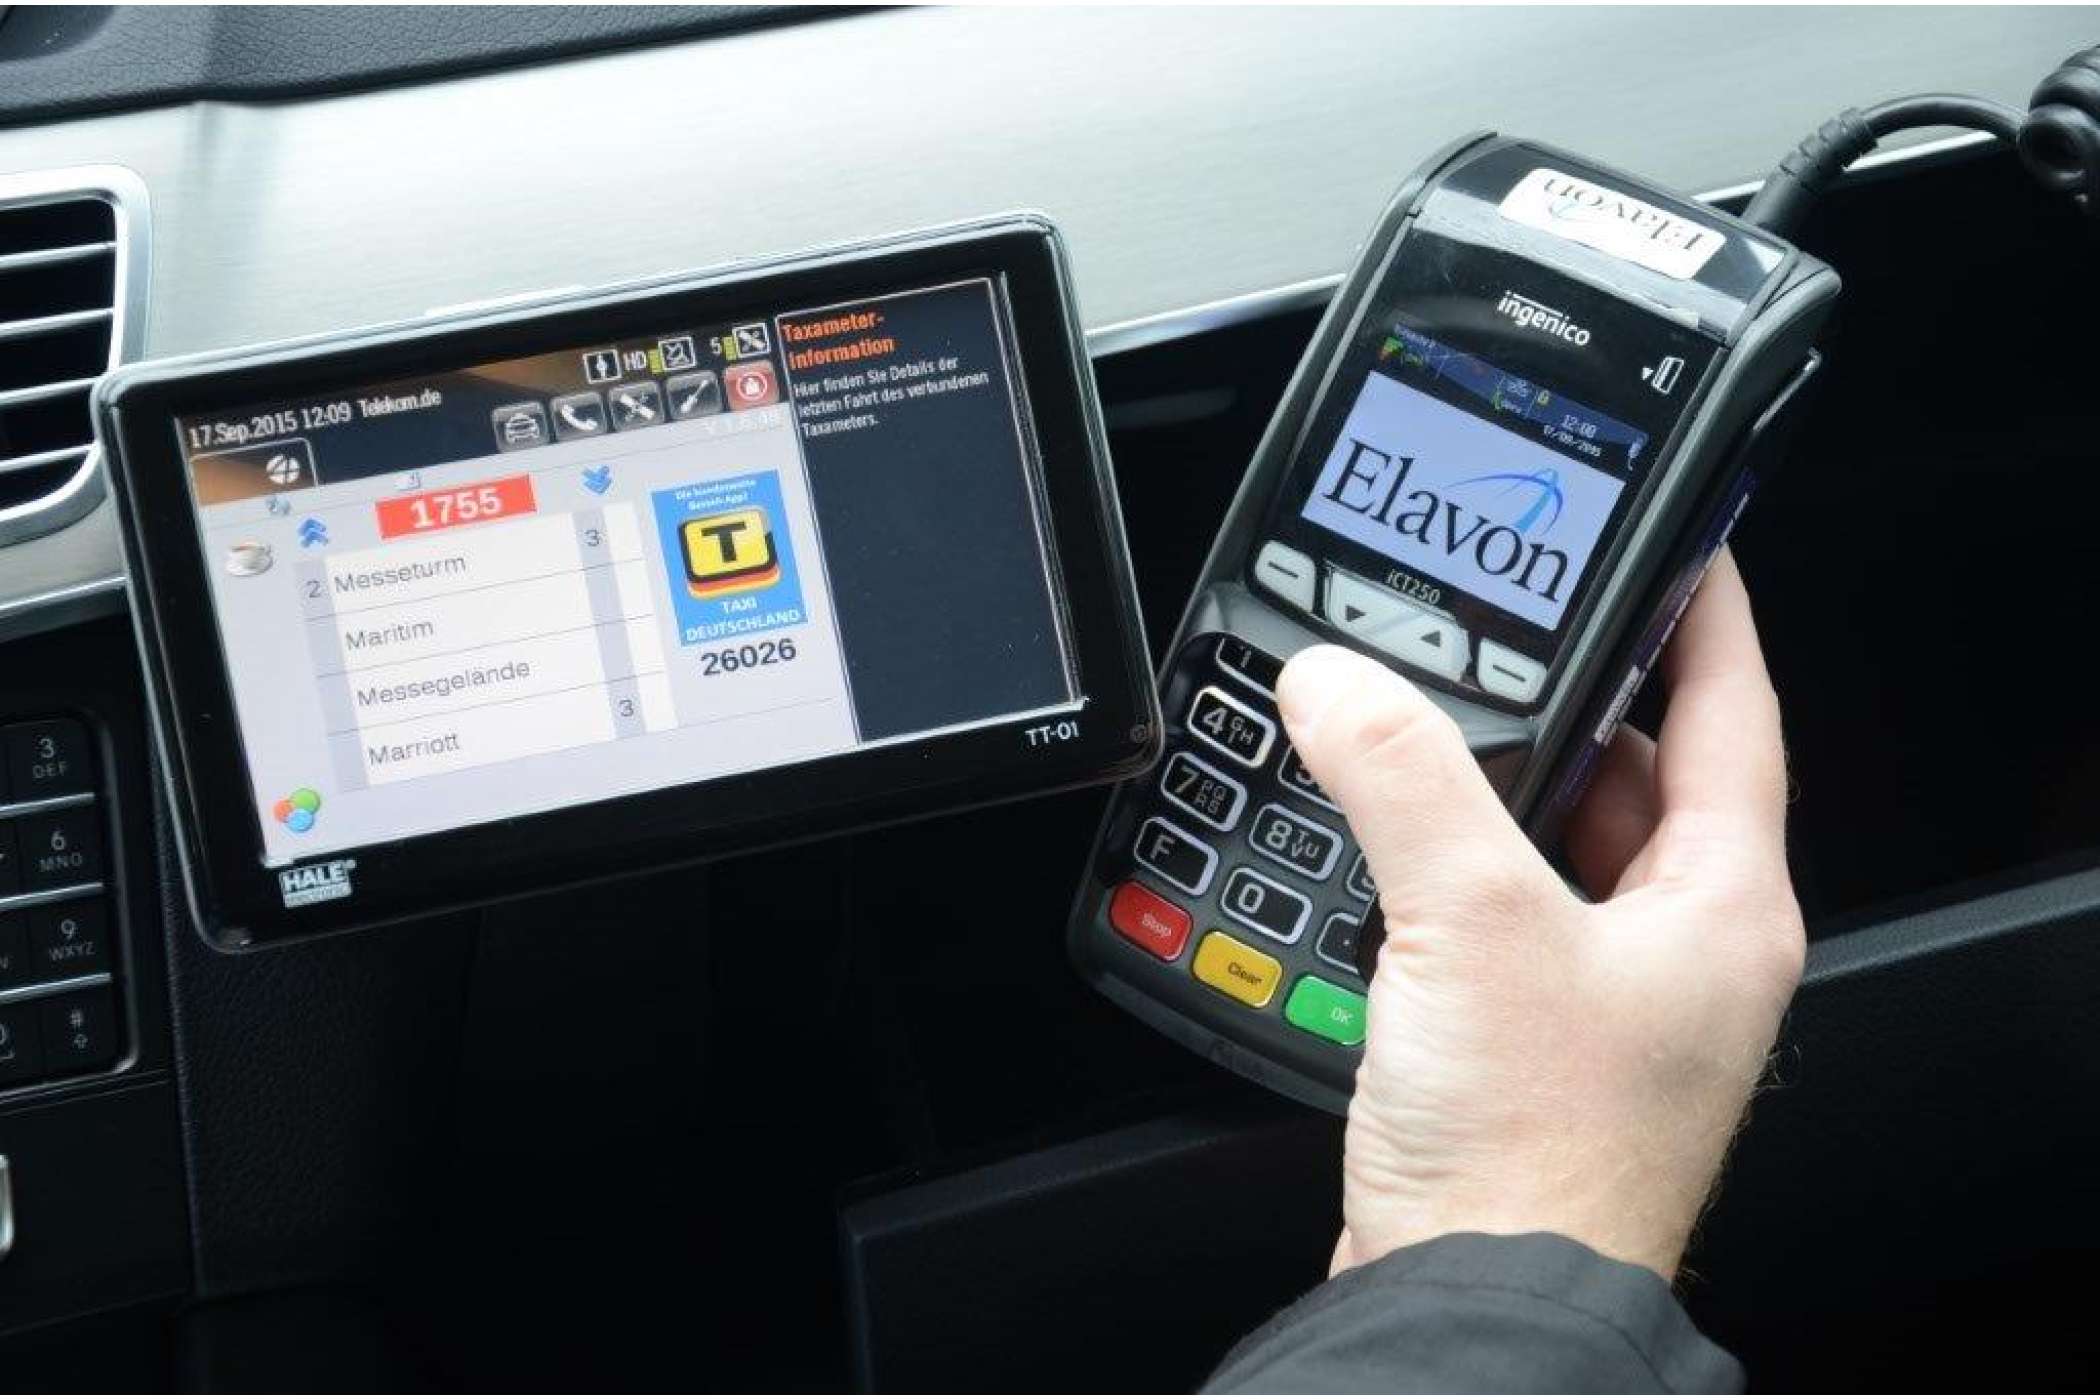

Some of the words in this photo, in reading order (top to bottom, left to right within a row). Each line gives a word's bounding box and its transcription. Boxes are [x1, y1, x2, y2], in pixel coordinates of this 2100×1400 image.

[783, 310, 885, 342] Taxameter-
[1497, 290, 1591, 346] ingenico
[824, 373, 865, 392] finden
[867, 368, 887, 384] Sie
[889, 362, 935, 381] Details
[939, 356, 959, 371] der
[844, 392, 880, 409] Fahrt
[881, 388, 905, 404] des
[906, 371, 990, 398] verbundenen
[302, 403, 351, 428] 12:09
[802, 413, 880, 437] Taxameters.
[410, 486, 502, 529] 1755
[1322, 437, 1570, 604] Elavon
[585, 529, 600, 548] 3
[701, 520, 748, 564] T
[307, 580, 322, 599] 2
[334, 554, 467, 594] Messeturm
[1384, 568, 1441, 605] iCT250
[721, 595, 758, 613] TAXI
[345, 619, 434, 651] Maritim
[685, 608, 800, 642] DEUTSCHLAND
[700, 637, 797, 677] 26026
[357, 660, 531, 707] Messegelände
[619, 699, 635, 718] 3
[1202, 706, 1228, 736] 4
[1024, 720, 1080, 746] TT-01
[38, 738, 55, 759] 3
[368, 731, 461, 766] Marriott
[32, 762, 69, 780] DEF
[1174, 766, 1199, 795] 7
[50, 830, 66, 852] 6
[1150, 834, 1176, 861] F
[1265, 820, 1293, 850] 8
[39, 852, 83, 873] MNO
[280, 861, 349, 893] HALE
[1238, 883, 1266, 914] 0
[60, 919, 76, 940] 9
[1141, 910, 1173, 939] Stop
[50, 941, 96, 962] WXYZ
[1227, 961, 1264, 987] Clear
[1330, 1006, 1353, 1024] OK
